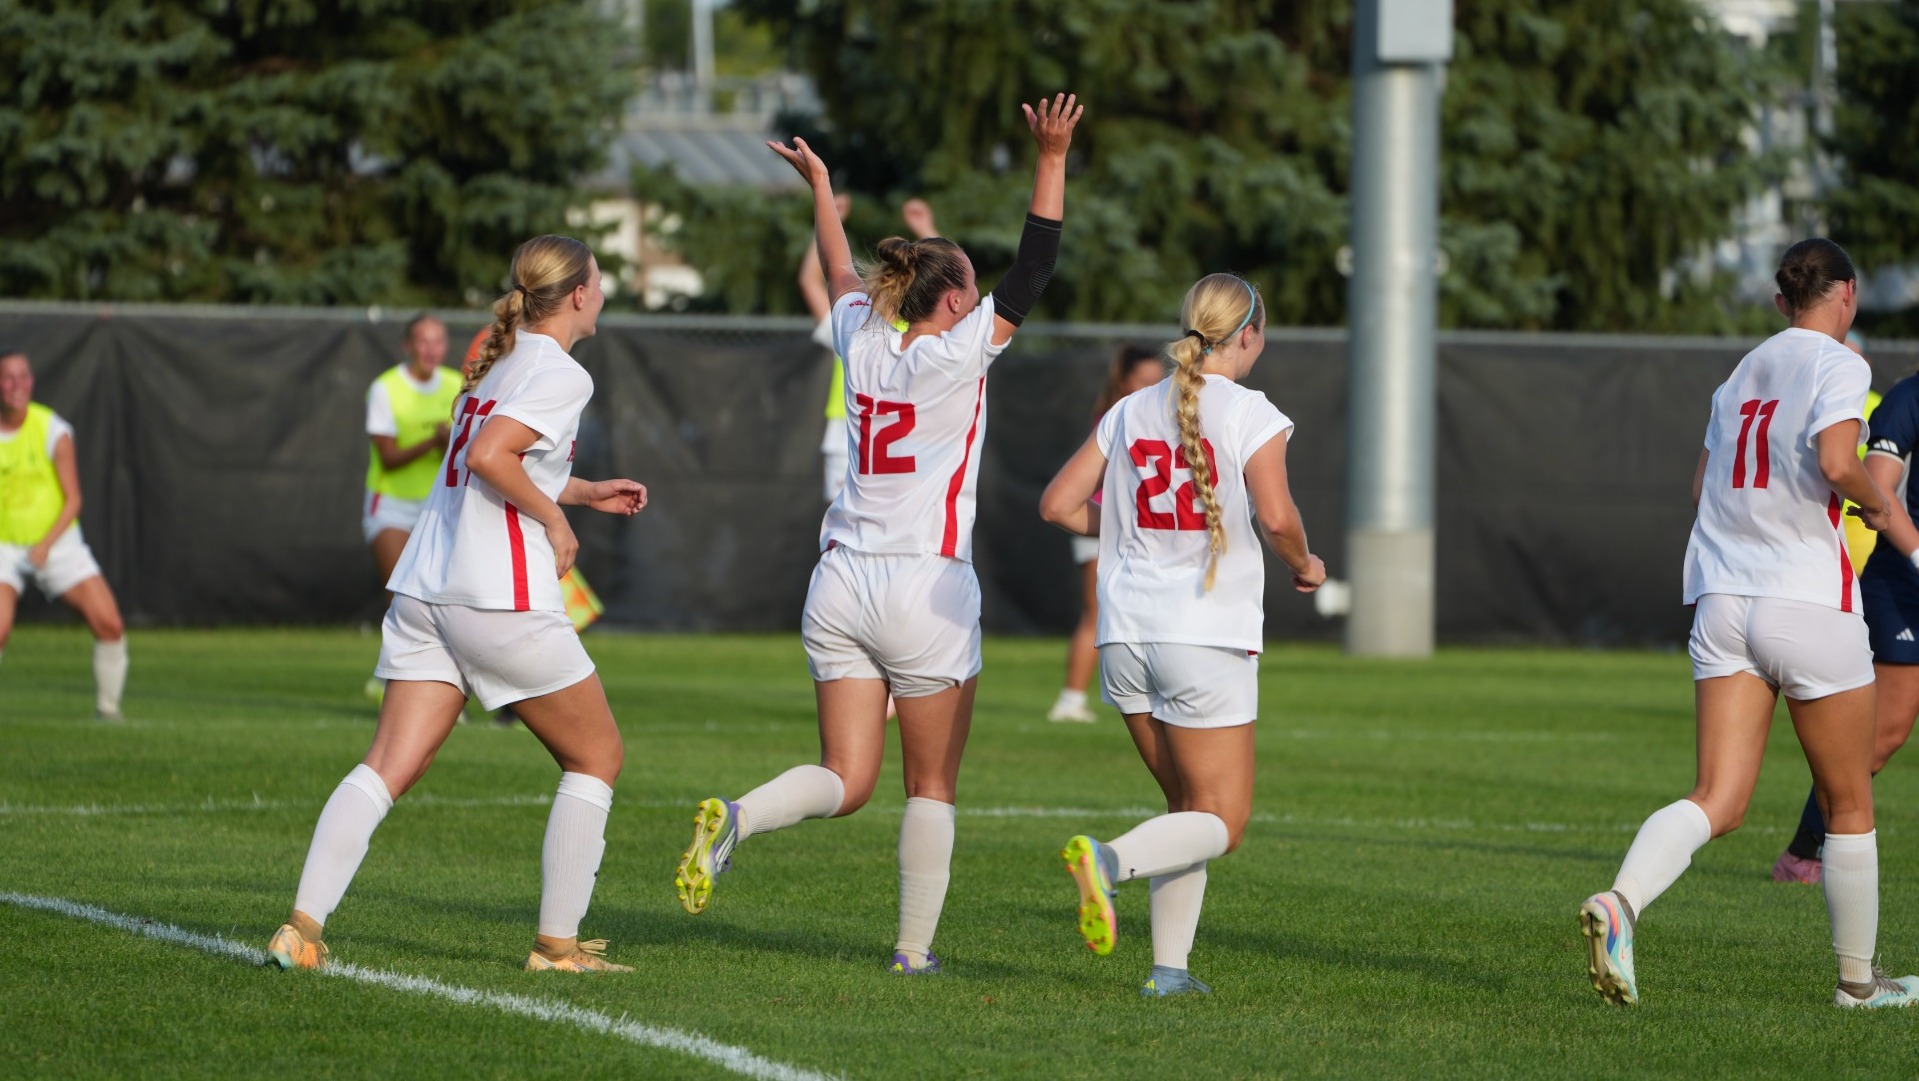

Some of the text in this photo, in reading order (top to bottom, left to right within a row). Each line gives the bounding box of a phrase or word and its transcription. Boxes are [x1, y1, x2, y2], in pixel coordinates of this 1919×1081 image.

[856, 393, 916, 475] 12
[1732, 399, 1779, 489] 11
[1129, 438, 1219, 531] 22
